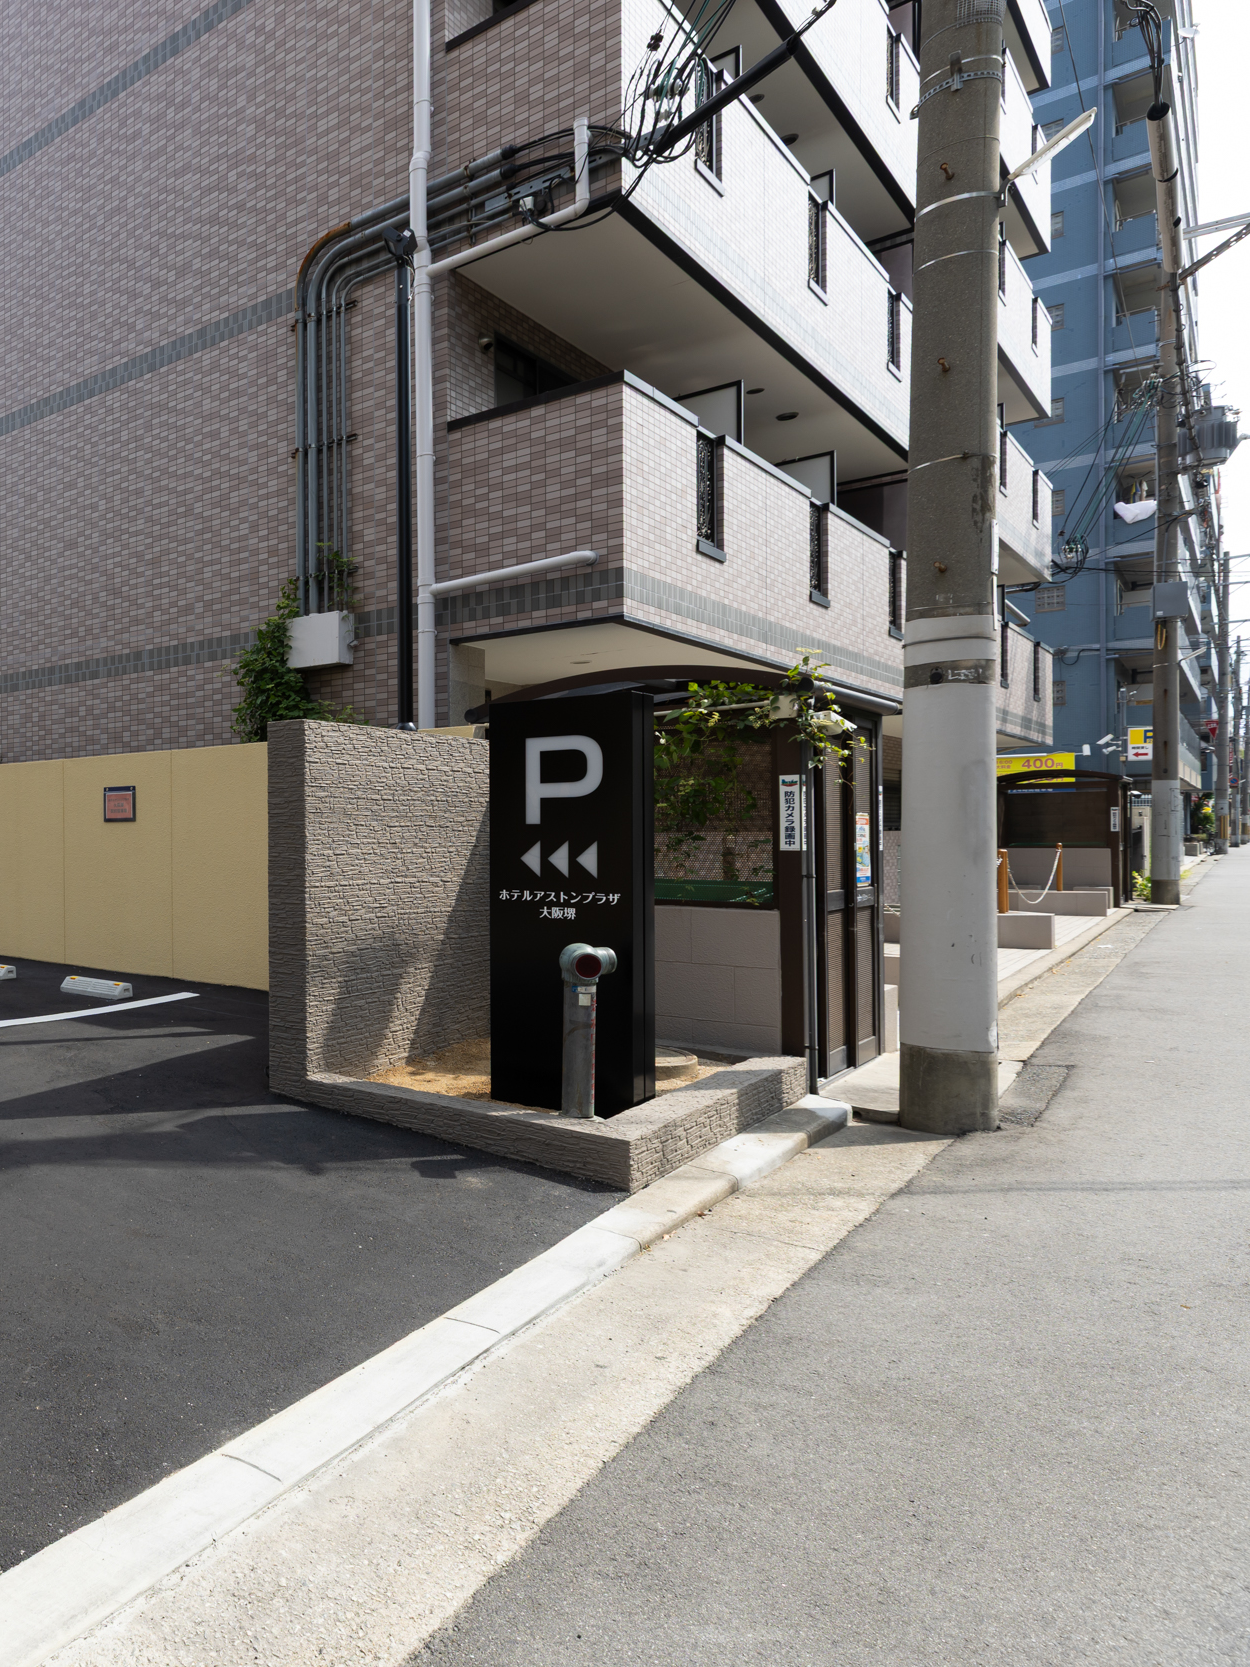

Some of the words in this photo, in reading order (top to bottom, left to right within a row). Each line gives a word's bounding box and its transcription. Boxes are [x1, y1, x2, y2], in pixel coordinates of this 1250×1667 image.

[525, 734, 604, 825] P
[784, 790, 796, 847] 防犯カメラ録画中
[499, 889, 621, 905] ホテルアストンプラザ
[539, 906, 577, 920] 大阪堺
